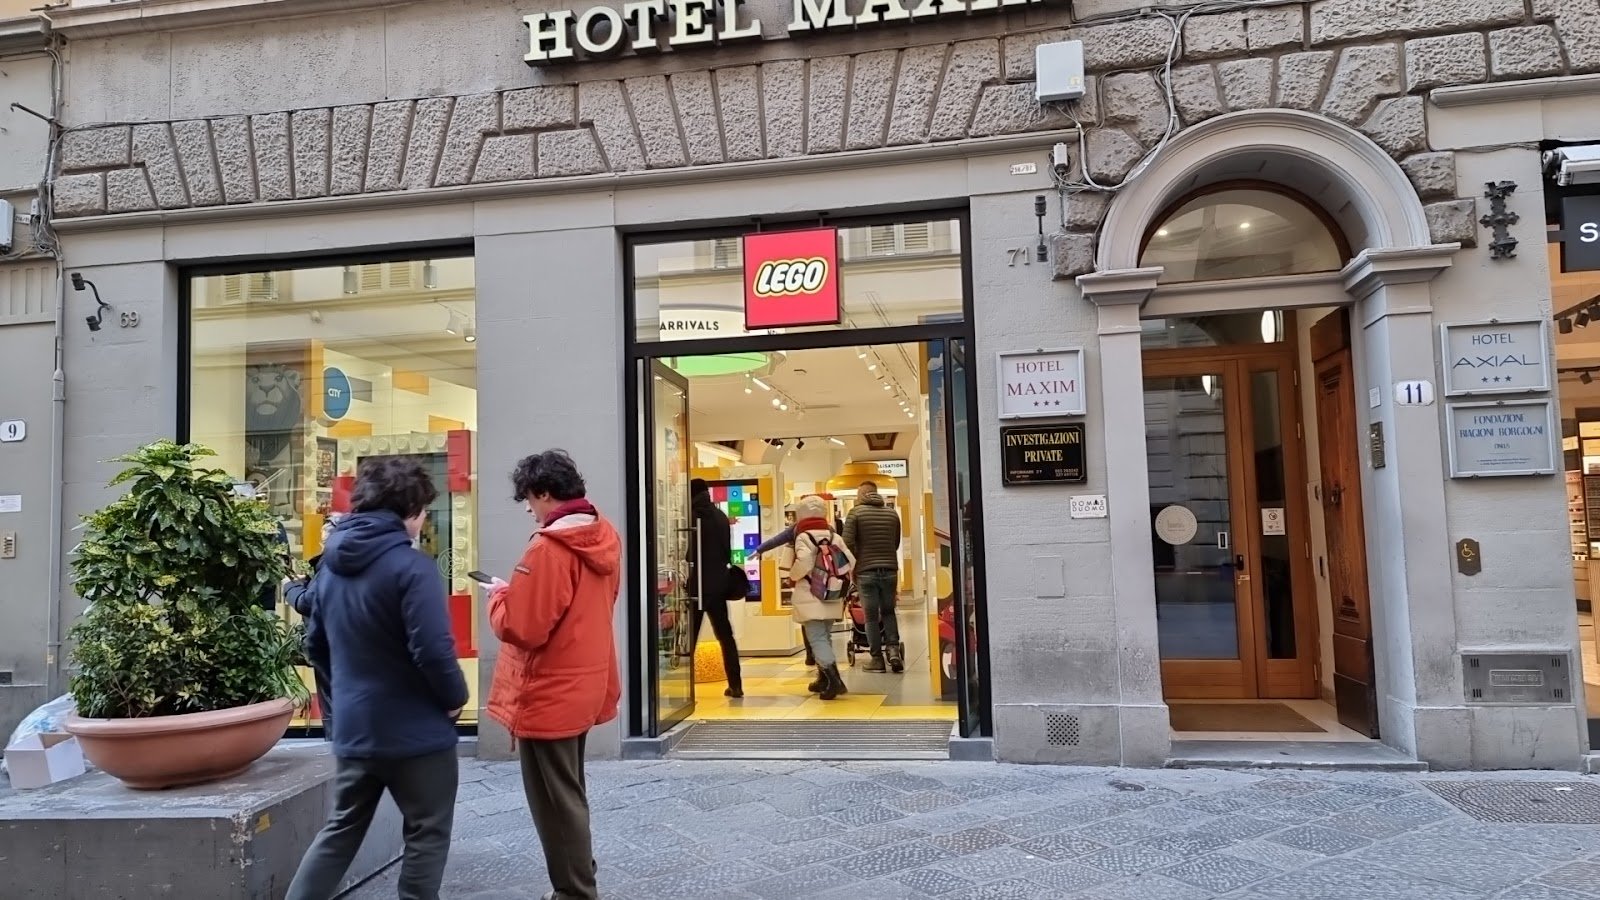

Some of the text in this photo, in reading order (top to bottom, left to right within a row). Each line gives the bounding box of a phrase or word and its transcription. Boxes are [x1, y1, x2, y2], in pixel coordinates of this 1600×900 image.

[522, 0, 762, 62] HOTEL
[1580, 222, 1600, 243] S
[1007, 246, 1031, 267] 71
[753, 256, 828, 298] LEGO
[120, 311, 139, 328] 69
[660, 320, 719, 331] ARRIVALS
[1472, 333, 1515, 345] HOTEL
[1016, 360, 1065, 373] HOTEL
[1453, 354, 1540, 369] AXIAL
[328, 387, 342, 399] CITY
[1007, 379, 1075, 396] MAXIM
[1404, 383, 1423, 404] 11
[1474, 413, 1525, 425] FONDAZIONE
[8, 423, 17, 438] 9
[1006, 431, 1080, 447] INVESTIGAZIONI
[1024, 450, 1063, 463] PRIVATE
